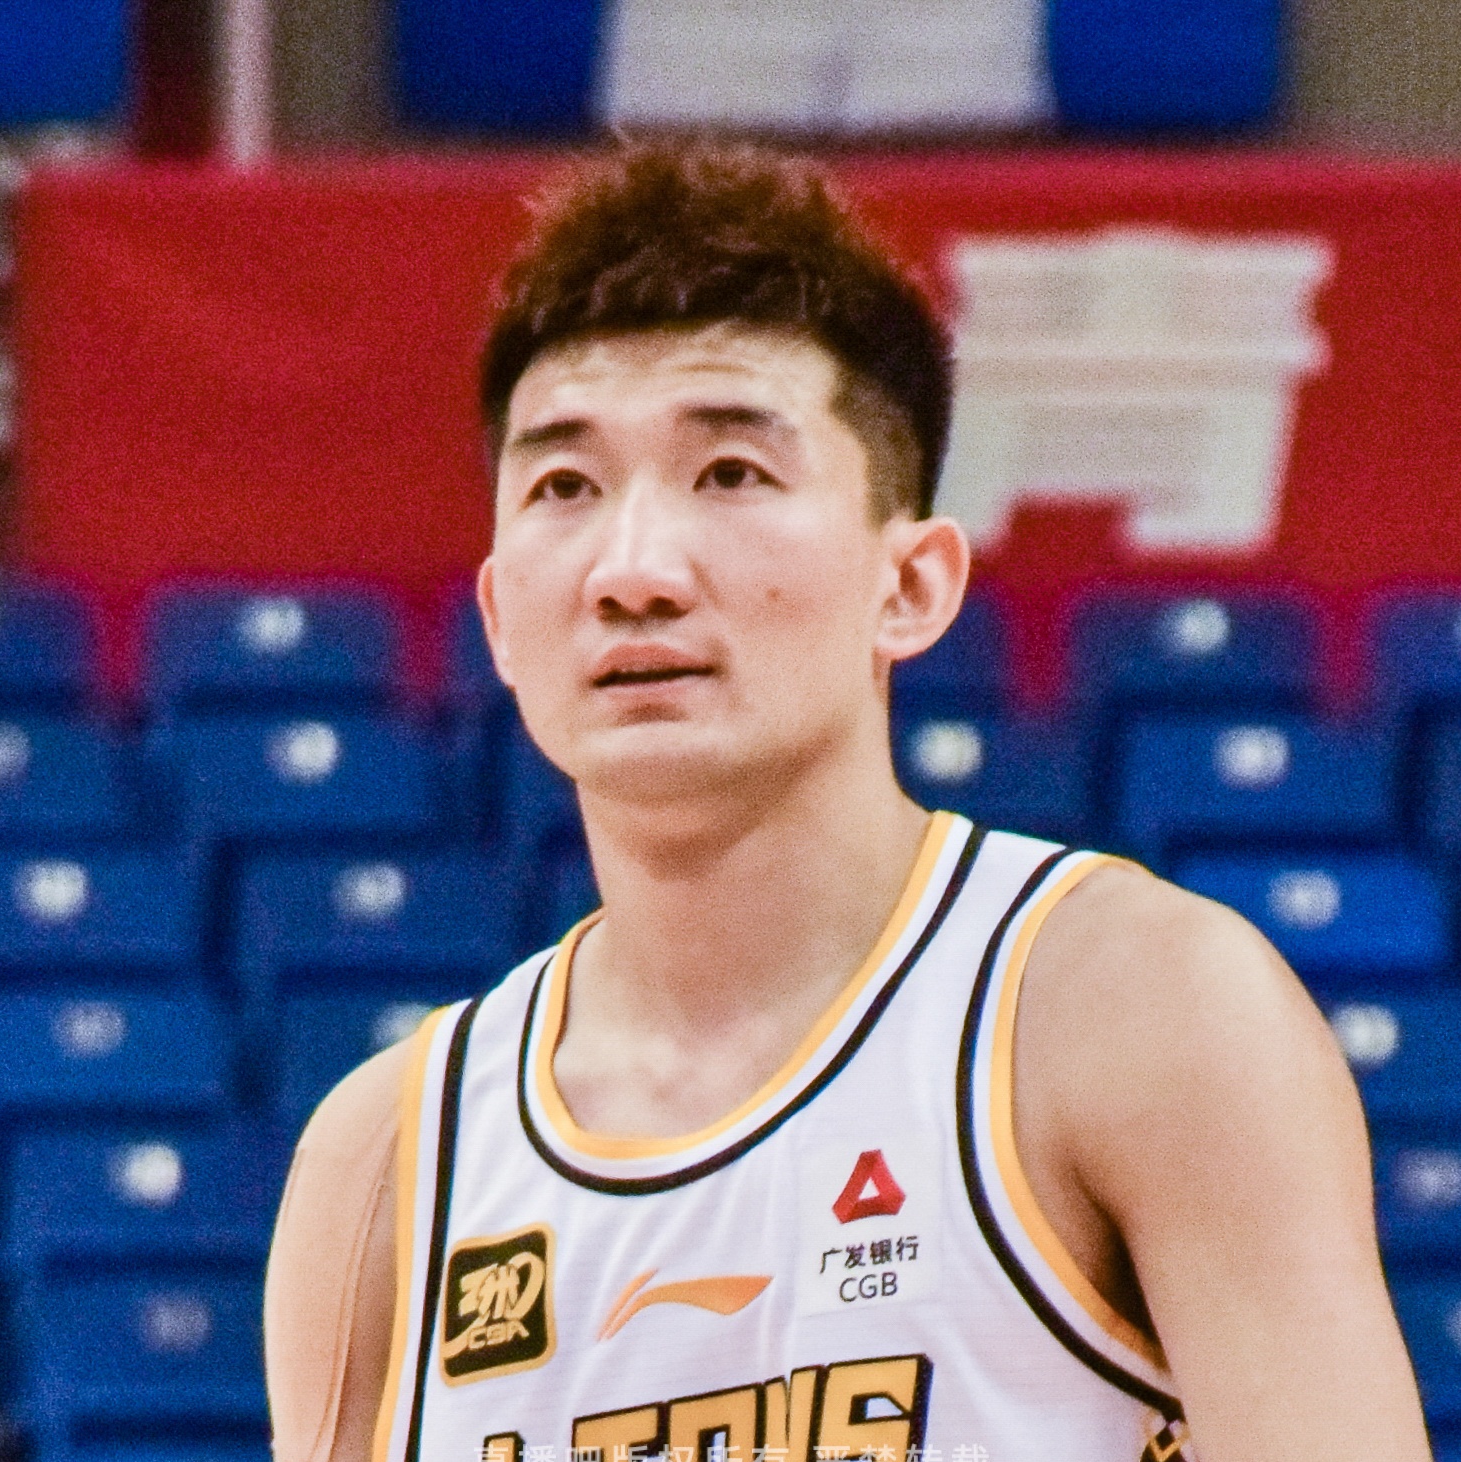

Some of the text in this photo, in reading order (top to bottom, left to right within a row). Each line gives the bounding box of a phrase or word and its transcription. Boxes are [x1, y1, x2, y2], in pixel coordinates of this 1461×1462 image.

[819, 1235, 920, 1275] 广发银行
[839, 1271, 899, 1303] CGB
